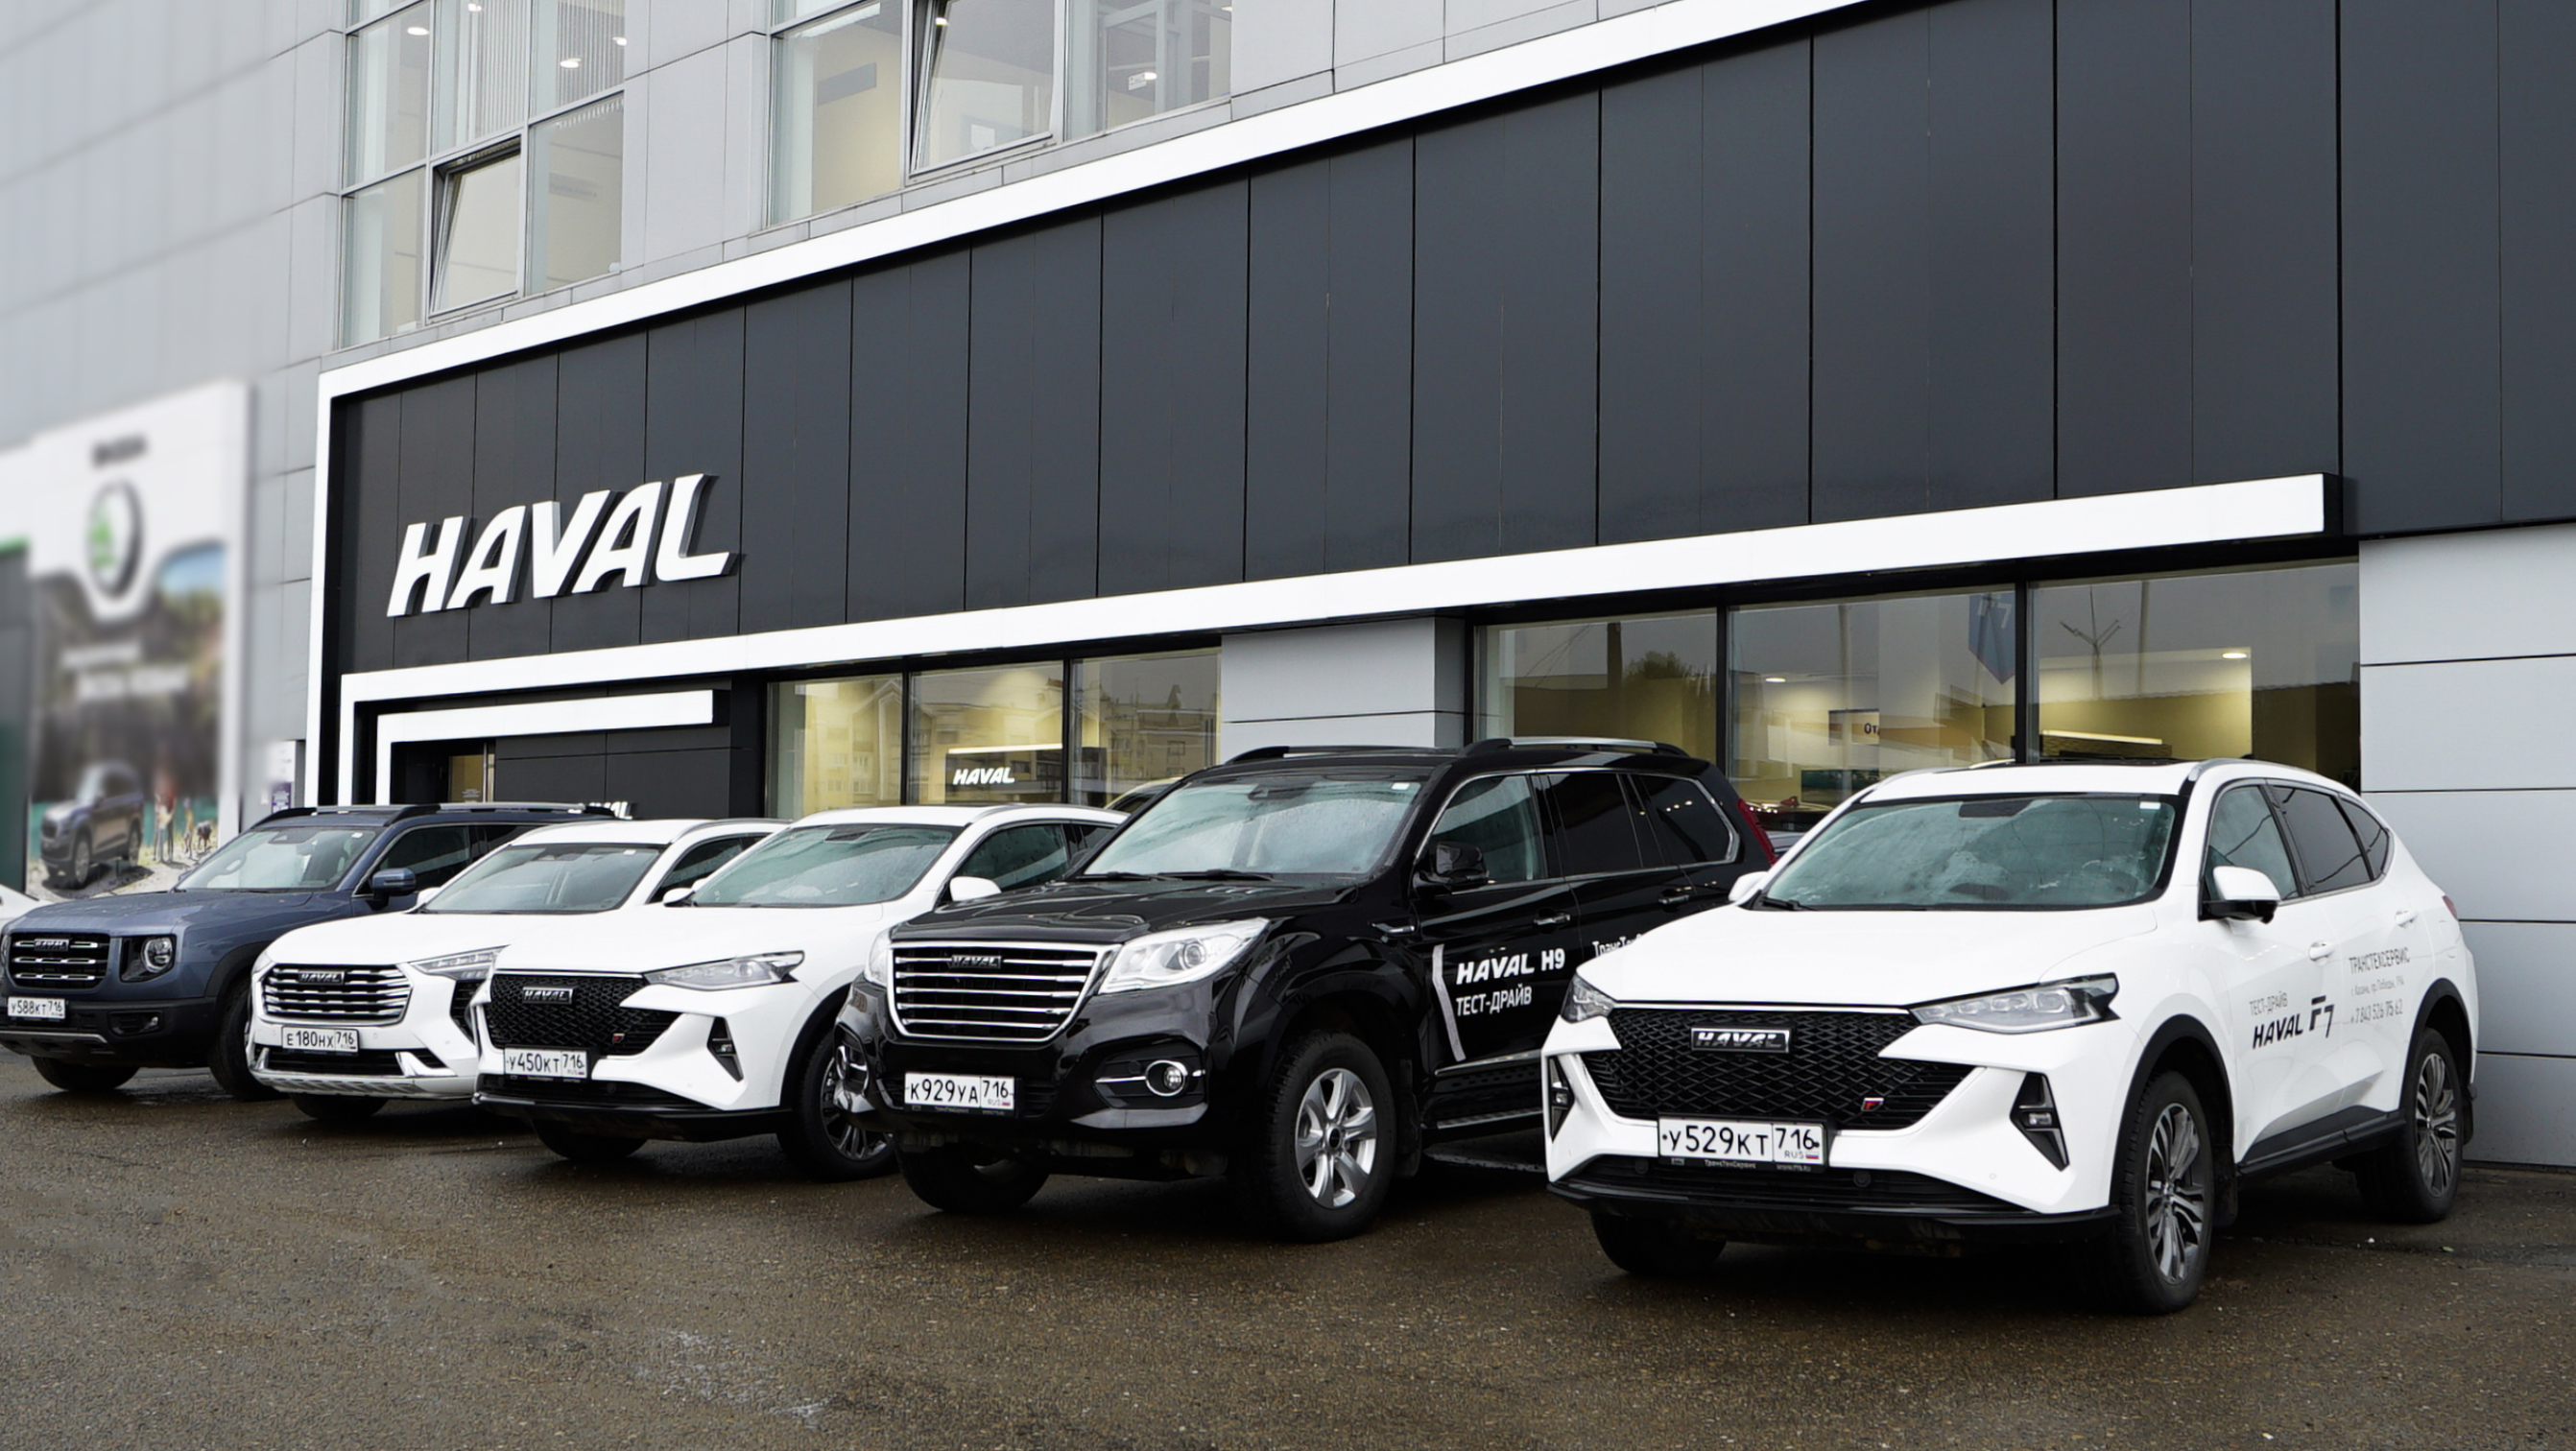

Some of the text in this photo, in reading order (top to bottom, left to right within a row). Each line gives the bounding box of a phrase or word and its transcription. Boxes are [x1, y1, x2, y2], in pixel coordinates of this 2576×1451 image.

[386, 473, 730, 617] HAVAL
[952, 767, 1015, 785] HAVAL
[1456, 948, 1565, 986] HAVAL H9
[299, 972, 341, 983] HAVAL
[1456, 983, 1532, 1017] ТЕСТ-ДРАЙВ
[2252, 995, 2335, 1050] HAVAL F7
[1695, 1032, 1782, 1048] HAVAL
[561, 1053, 584, 1069] 716
[983, 1080, 1009, 1099] 716
[1775, 1127, 1816, 1151] 716
[1783, 1150, 1805, 1160] RUS
